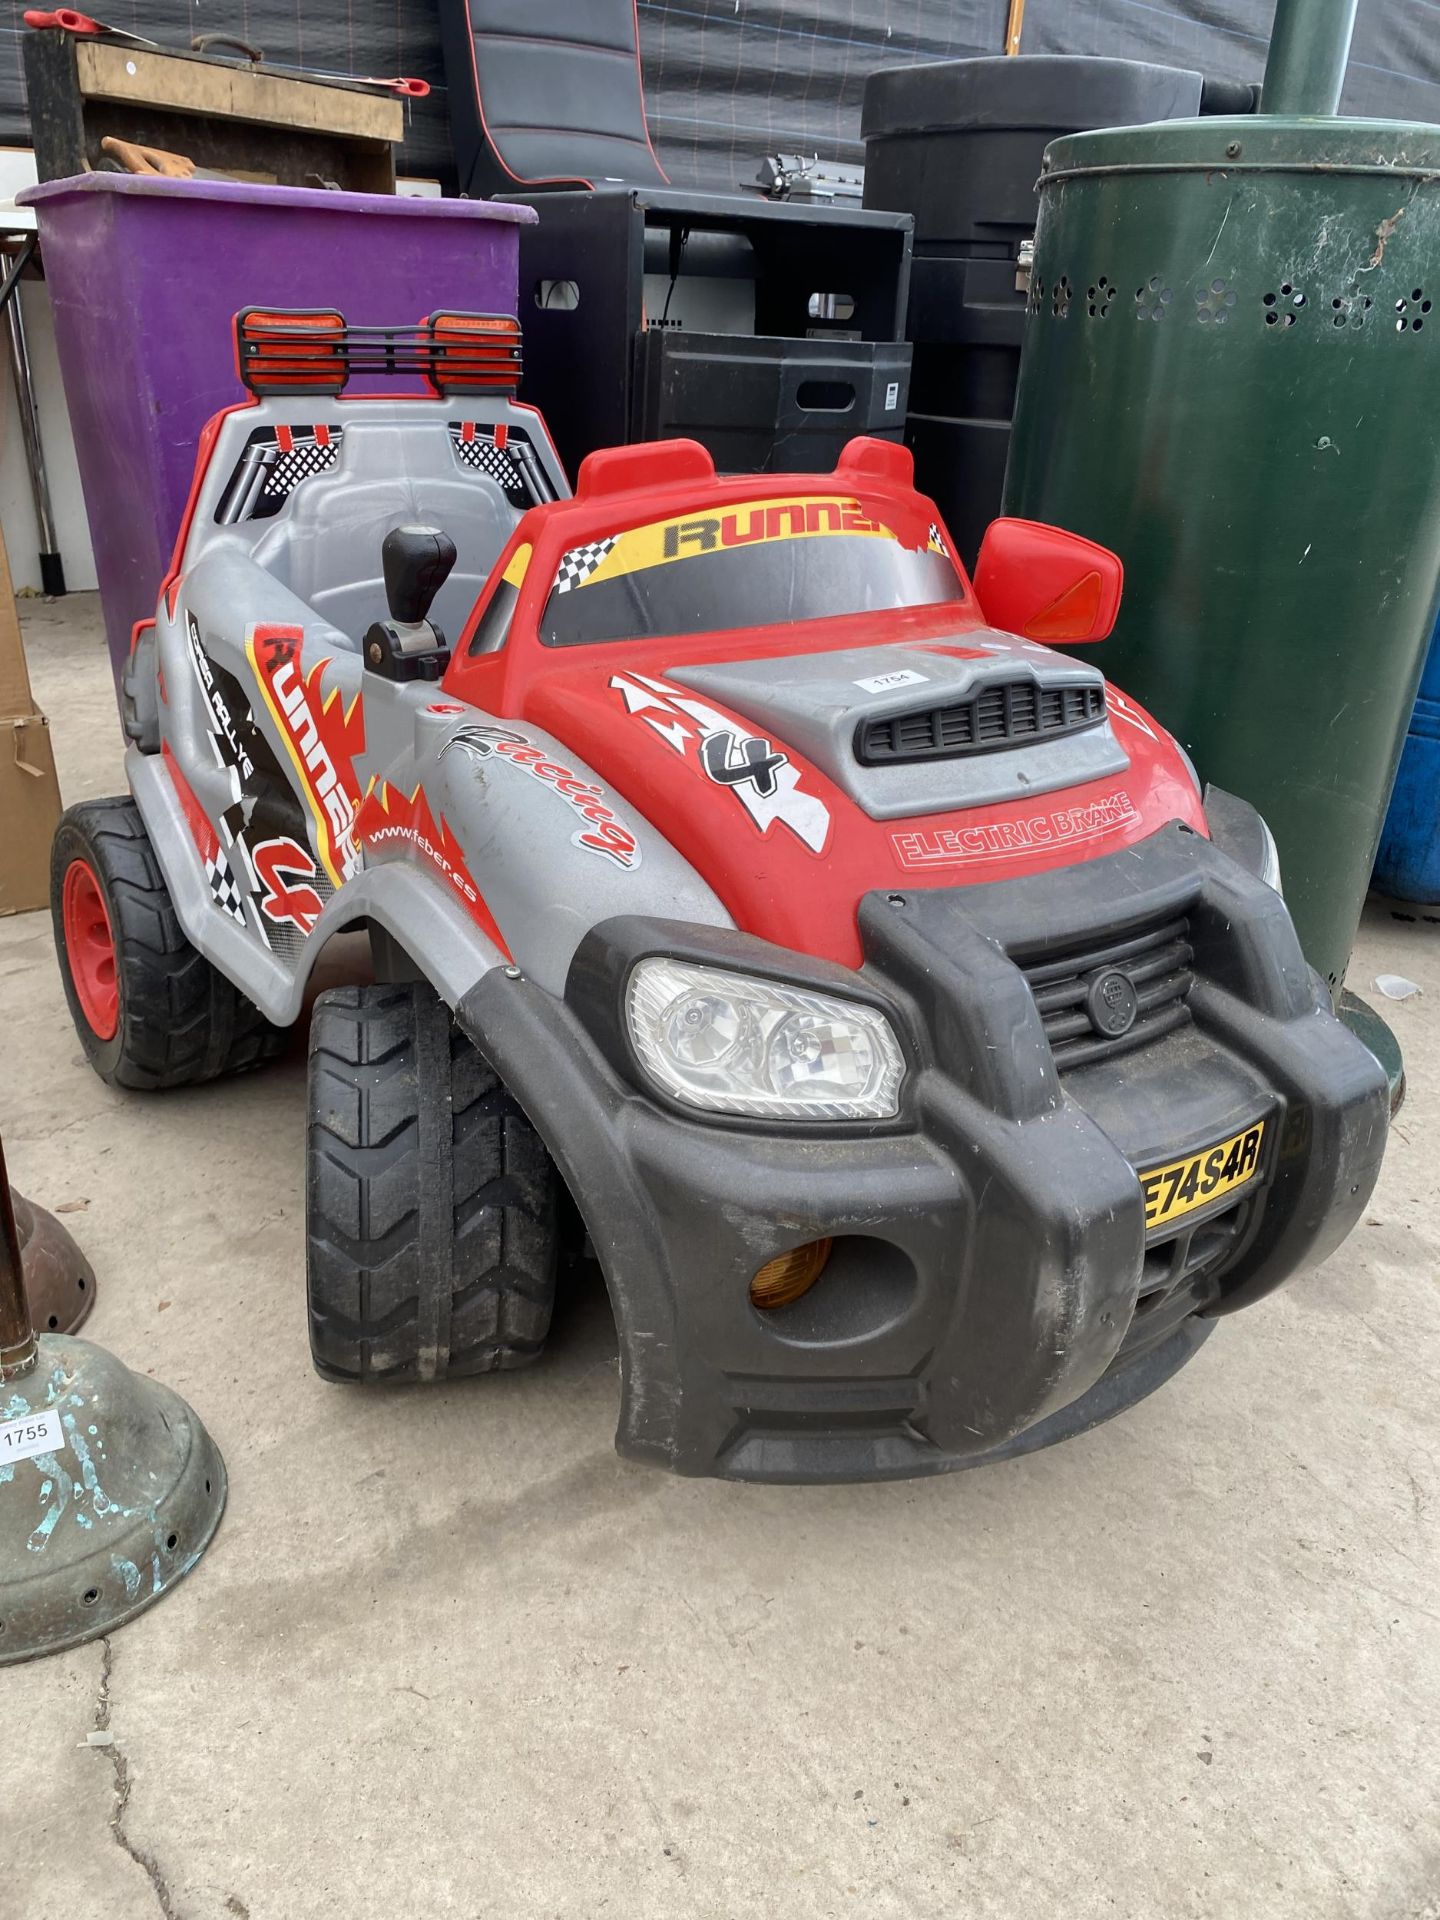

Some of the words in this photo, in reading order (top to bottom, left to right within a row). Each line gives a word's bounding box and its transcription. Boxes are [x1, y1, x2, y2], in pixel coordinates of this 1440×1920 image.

[190, 622, 214, 691] CORSA
[212, 690, 255, 780] RALLYE
[437, 724, 637, 867] Racing
[699, 728, 789, 799] 4
[891, 816, 1053, 867] ELECTRIC
[1050, 791, 1135, 838] BRAKE
[3, 1423, 48, 1447] 1755
